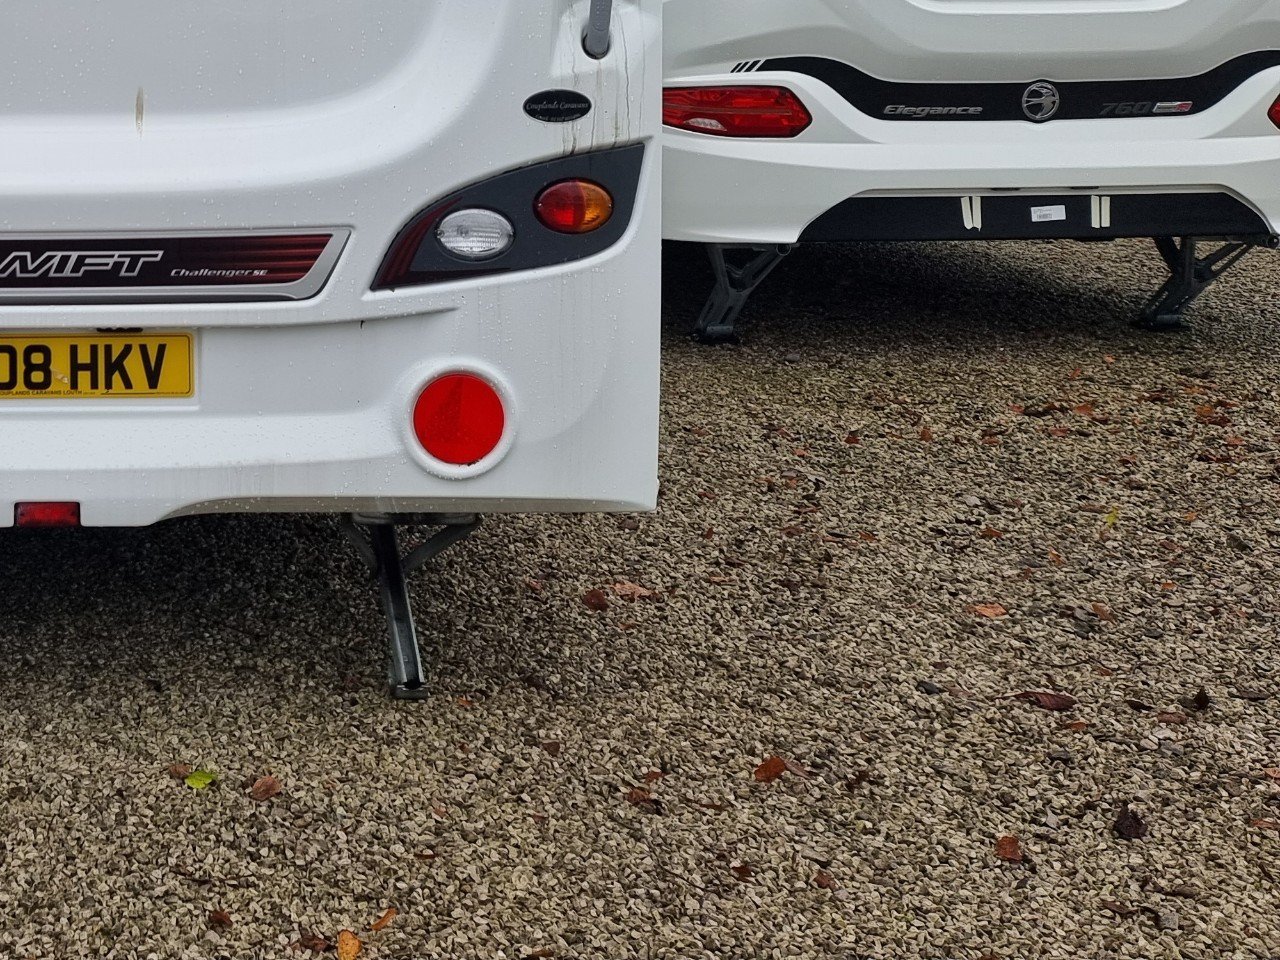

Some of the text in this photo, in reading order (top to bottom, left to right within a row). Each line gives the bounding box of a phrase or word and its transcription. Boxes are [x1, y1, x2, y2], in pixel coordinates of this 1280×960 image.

[883, 104, 984, 117] Elegance
[1100, 101, 1152, 115] 760
[170, 268, 253, 278] Challenger
[70, 344, 167, 390] HKV
